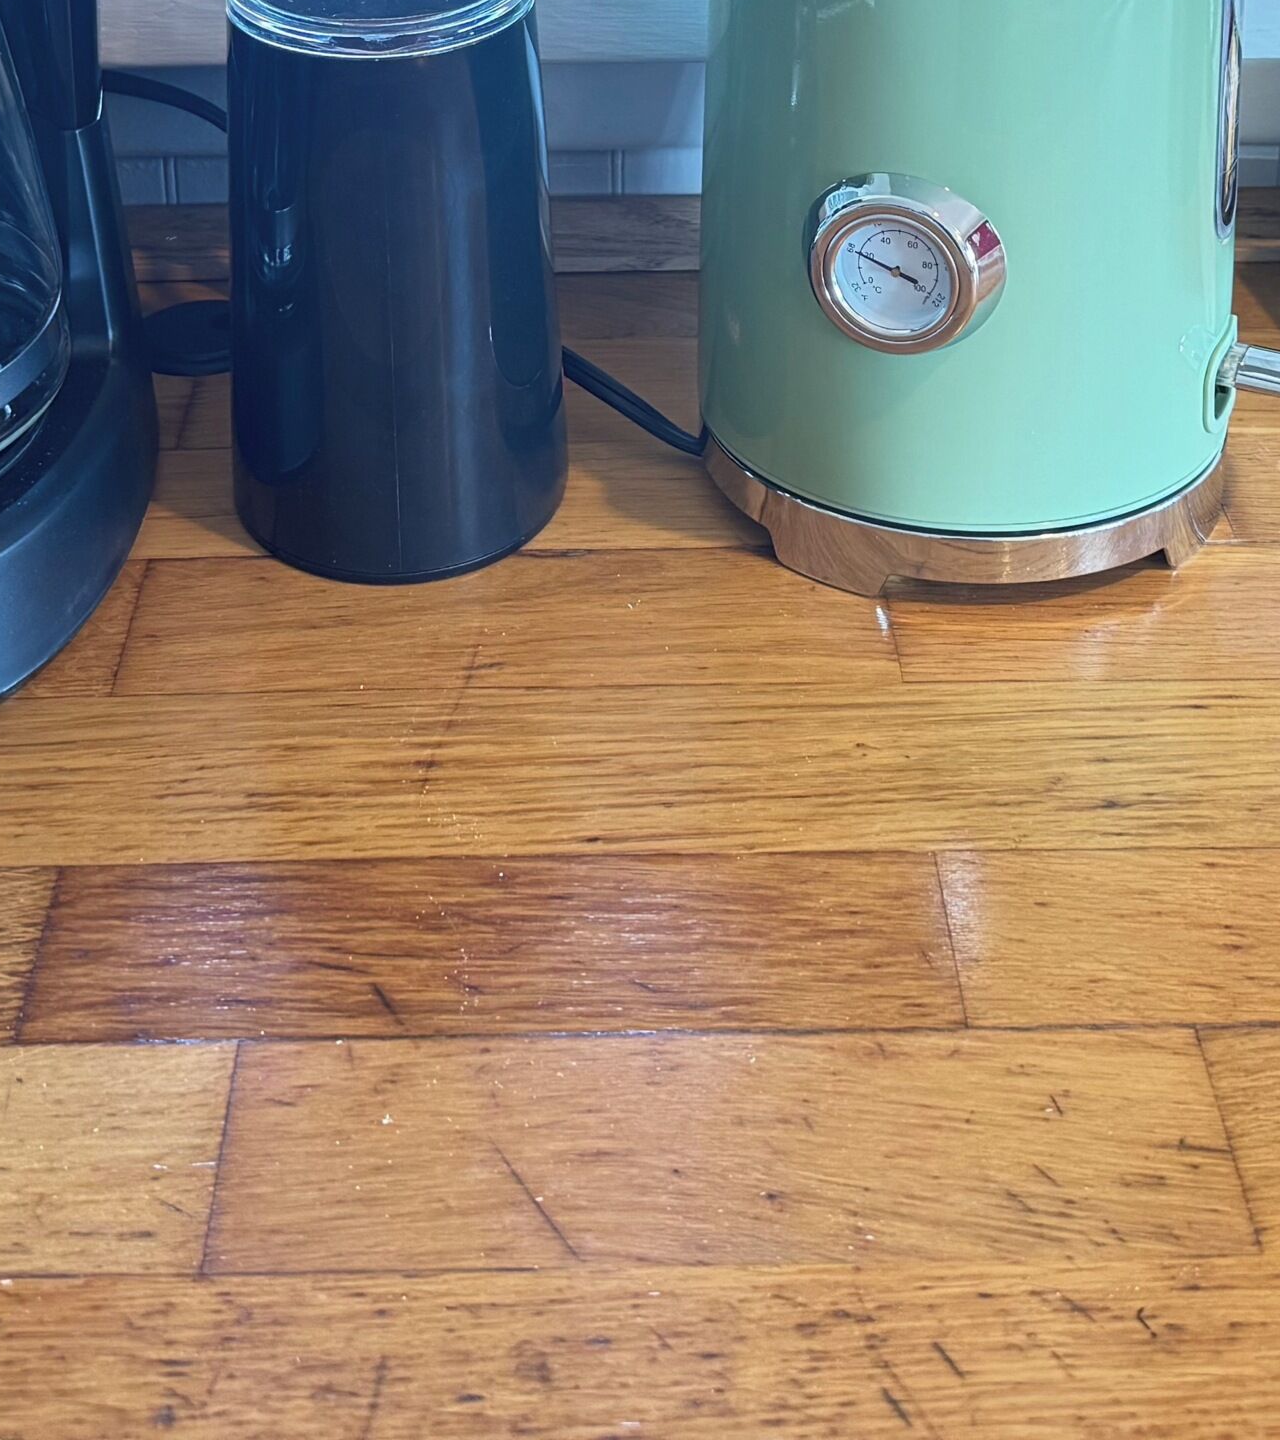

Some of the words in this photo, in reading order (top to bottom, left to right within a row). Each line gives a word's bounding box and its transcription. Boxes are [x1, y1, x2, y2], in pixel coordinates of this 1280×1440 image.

[880, 237, 891, 245] 40
[907, 240, 919, 249] 60
[922, 261, 933, 270] 80
[913, 282, 927, 292] 00
